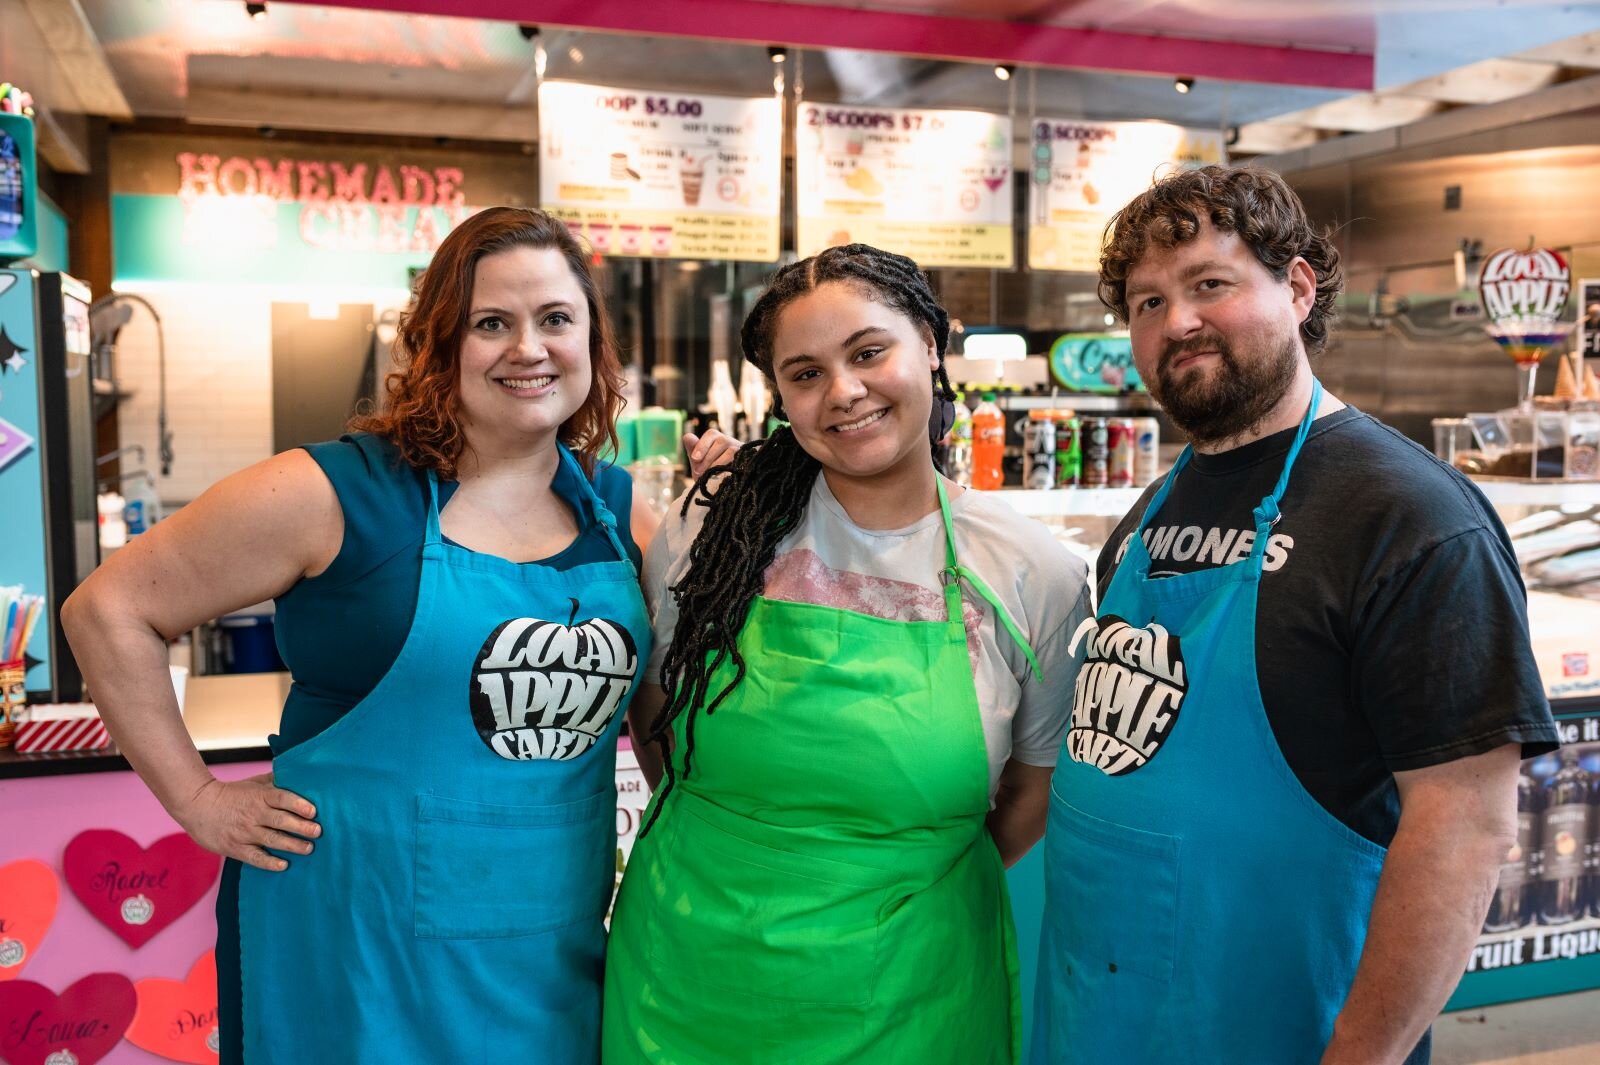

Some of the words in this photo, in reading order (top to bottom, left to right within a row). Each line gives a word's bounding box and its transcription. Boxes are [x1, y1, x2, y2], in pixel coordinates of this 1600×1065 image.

[645, 97, 703, 117] $5.00
[807, 108, 820, 126] 2
[825, 111, 894, 129] SCOOPS
[1055, 124, 1117, 142] SCOOPS
[175, 152, 465, 207] HOMEMADE
[1482, 248, 1569, 281] LOCAL
[1482, 280, 1569, 320] APPLE
[480, 617, 638, 676] LOCAL
[1071, 661, 1184, 758] APPLE
[490, 728, 597, 761] CART
[1066, 729, 1146, 775] CART
[616, 781, 641, 793] ADE
[1466, 934, 1525, 972] ruit
[1532, 927, 1600, 961] Liqu
